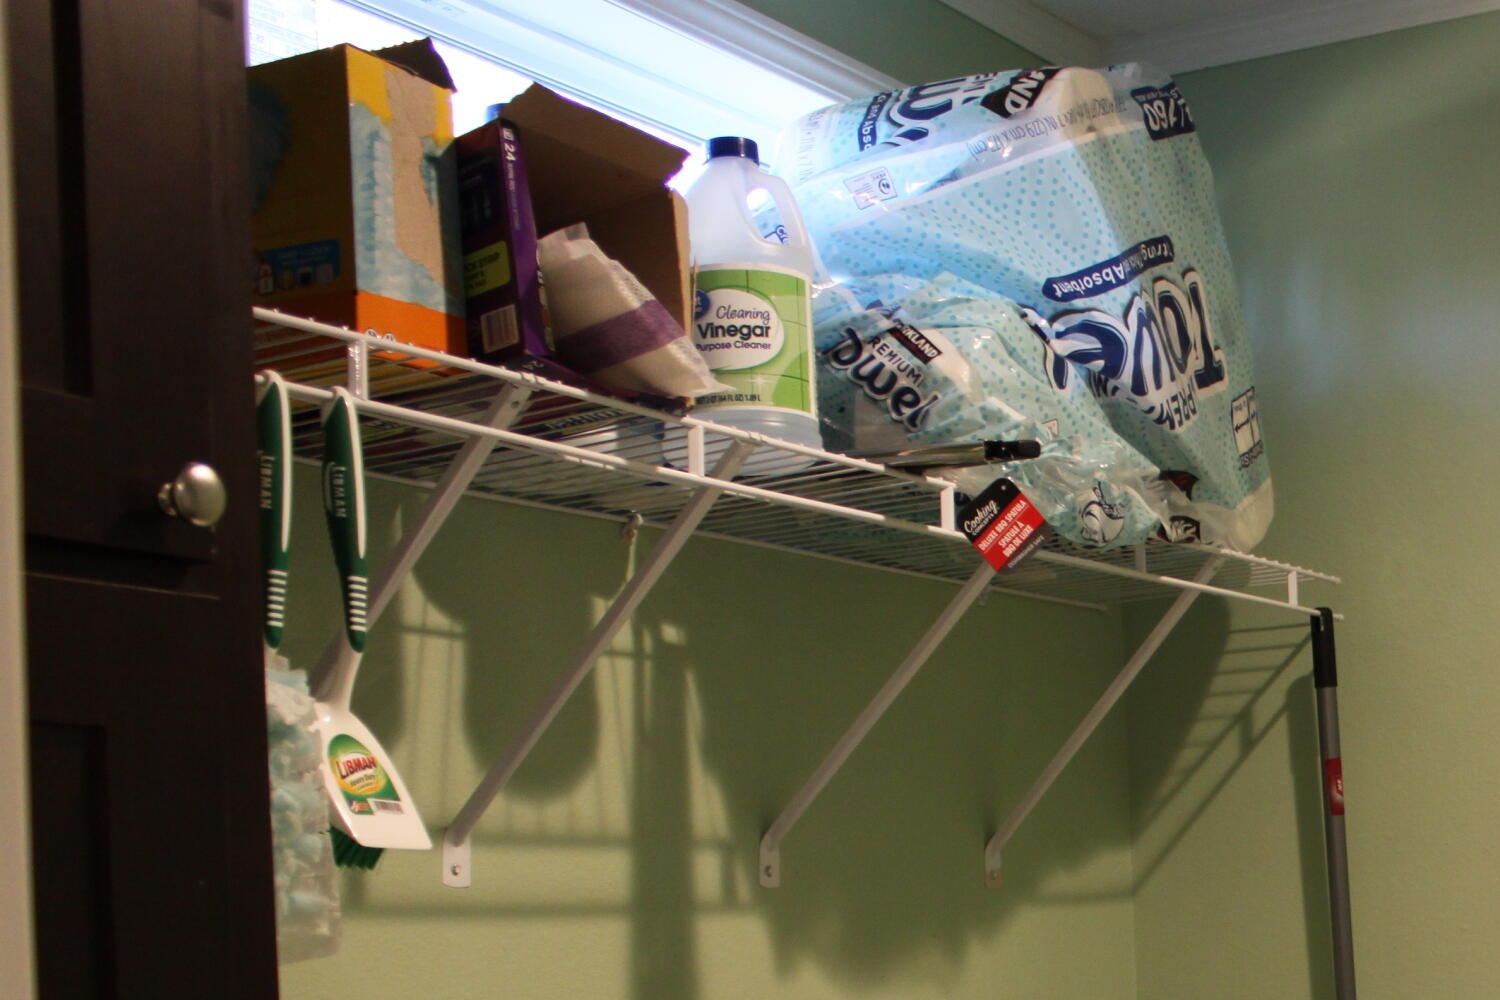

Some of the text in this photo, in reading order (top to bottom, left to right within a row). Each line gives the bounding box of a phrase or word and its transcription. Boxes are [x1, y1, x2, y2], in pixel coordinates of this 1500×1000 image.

[715, 303, 771, 325] Cleaning
[696, 322, 771, 341] Vinegar
[733, 341, 771, 351] Cleaner
[328, 461, 347, 518] LIBMAN
[963, 499, 999, 533] Cooking
[978, 529, 998, 551] DELUXE
[1004, 499, 1027, 522] SPATULA
[335, 756, 377, 780] LIBMAN
